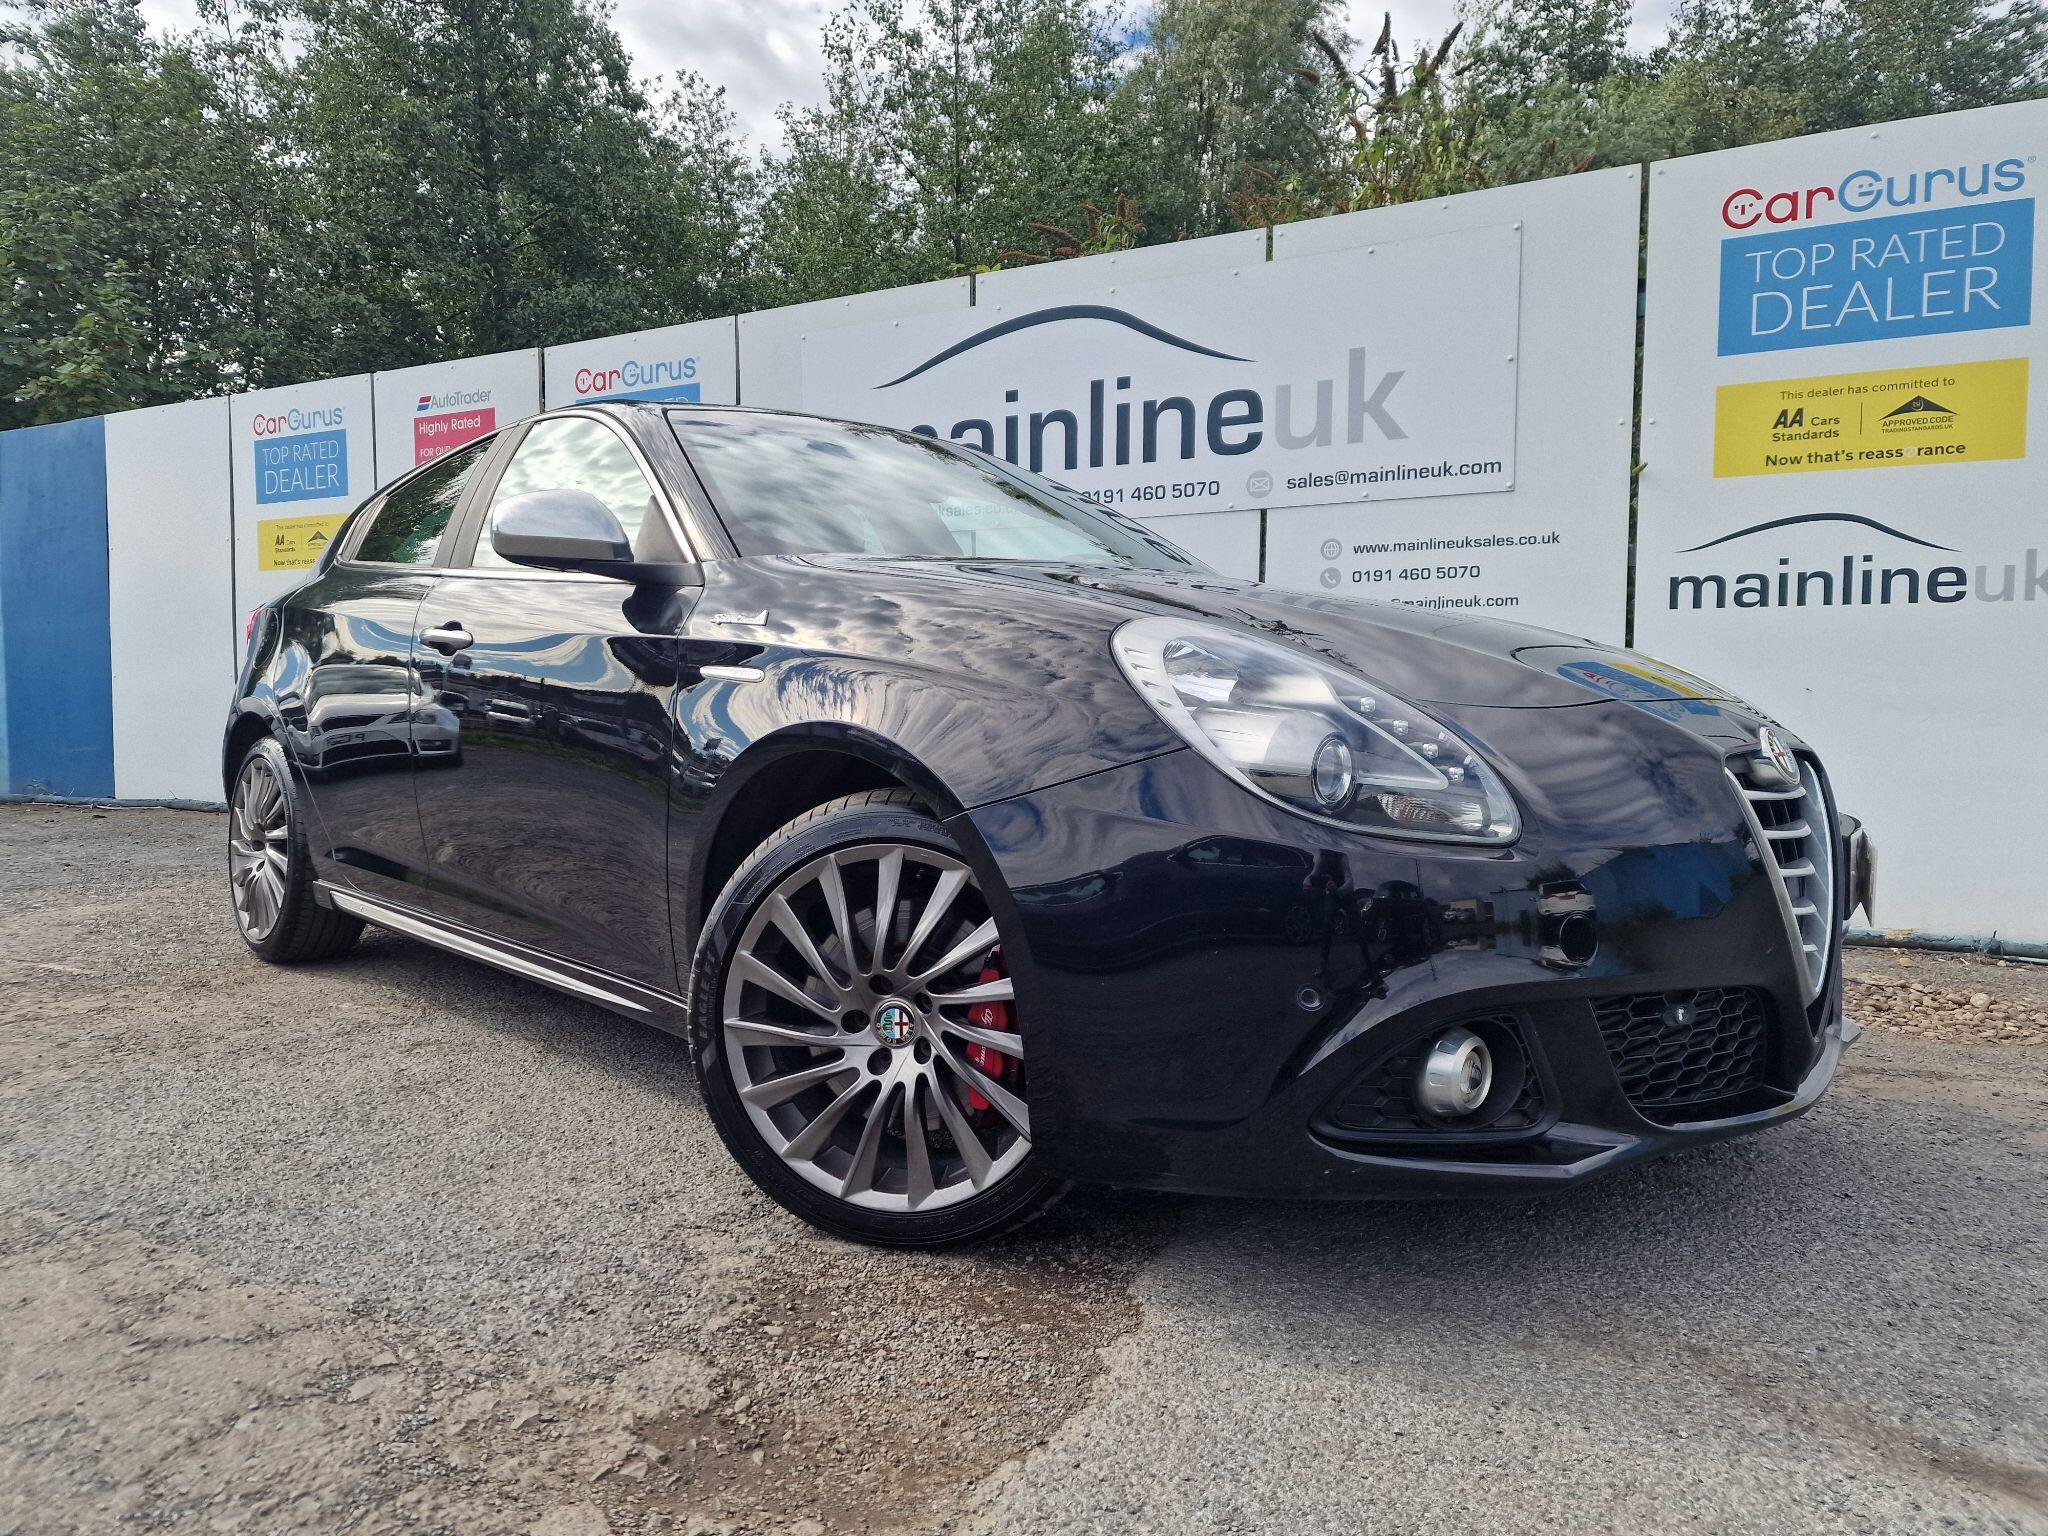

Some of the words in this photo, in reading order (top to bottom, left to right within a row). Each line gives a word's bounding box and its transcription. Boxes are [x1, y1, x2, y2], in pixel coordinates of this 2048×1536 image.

[1722, 158, 2025, 229] CarGurus
[1745, 243, 1836, 283] TOP
[1851, 221, 2006, 271] RATED
[1751, 266, 2001, 336] DEALER
[574, 357, 696, 394] CarGurus
[1780, 391, 1804, 400] This
[1807, 386, 1845, 398] dealer
[1847, 385, 1869, 395] has
[1872, 378, 1939, 393] committed
[1942, 377, 1956, 386] to
[253, 408, 343, 436] CarGurus
[911, 347, 1408, 473] ainlineuk
[1772, 408, 1805, 429] AA
[1811, 416, 1841, 427] Cars
[1882, 417, 1929, 428] APPROVED
[1930, 415, 1954, 424] CODE
[419, 421, 448, 436] Highly
[451, 415, 481, 430] Rated
[1772, 428, 1840, 442] Standards
[262, 446, 289, 466] TOP
[293, 440, 339, 462] RATED
[420, 448, 434, 457] FOR
[1765, 454, 1803, 467] Now
[1807, 450, 1854, 464] that's
[1858, 443, 1967, 461] reassrance
[264, 464, 340, 494] DEALER
[1131, 485, 1166, 501] 460
[1172, 481, 1220, 498] 5070
[1286, 458, 1502, 490] sales@mainlineuk.com
[1353, 531, 1561, 554] www.mainlineuksales.co.uk
[1352, 569, 1392, 583] 0191
[1398, 567, 1431, 581] 460
[1436, 565, 1481, 580] 5070
